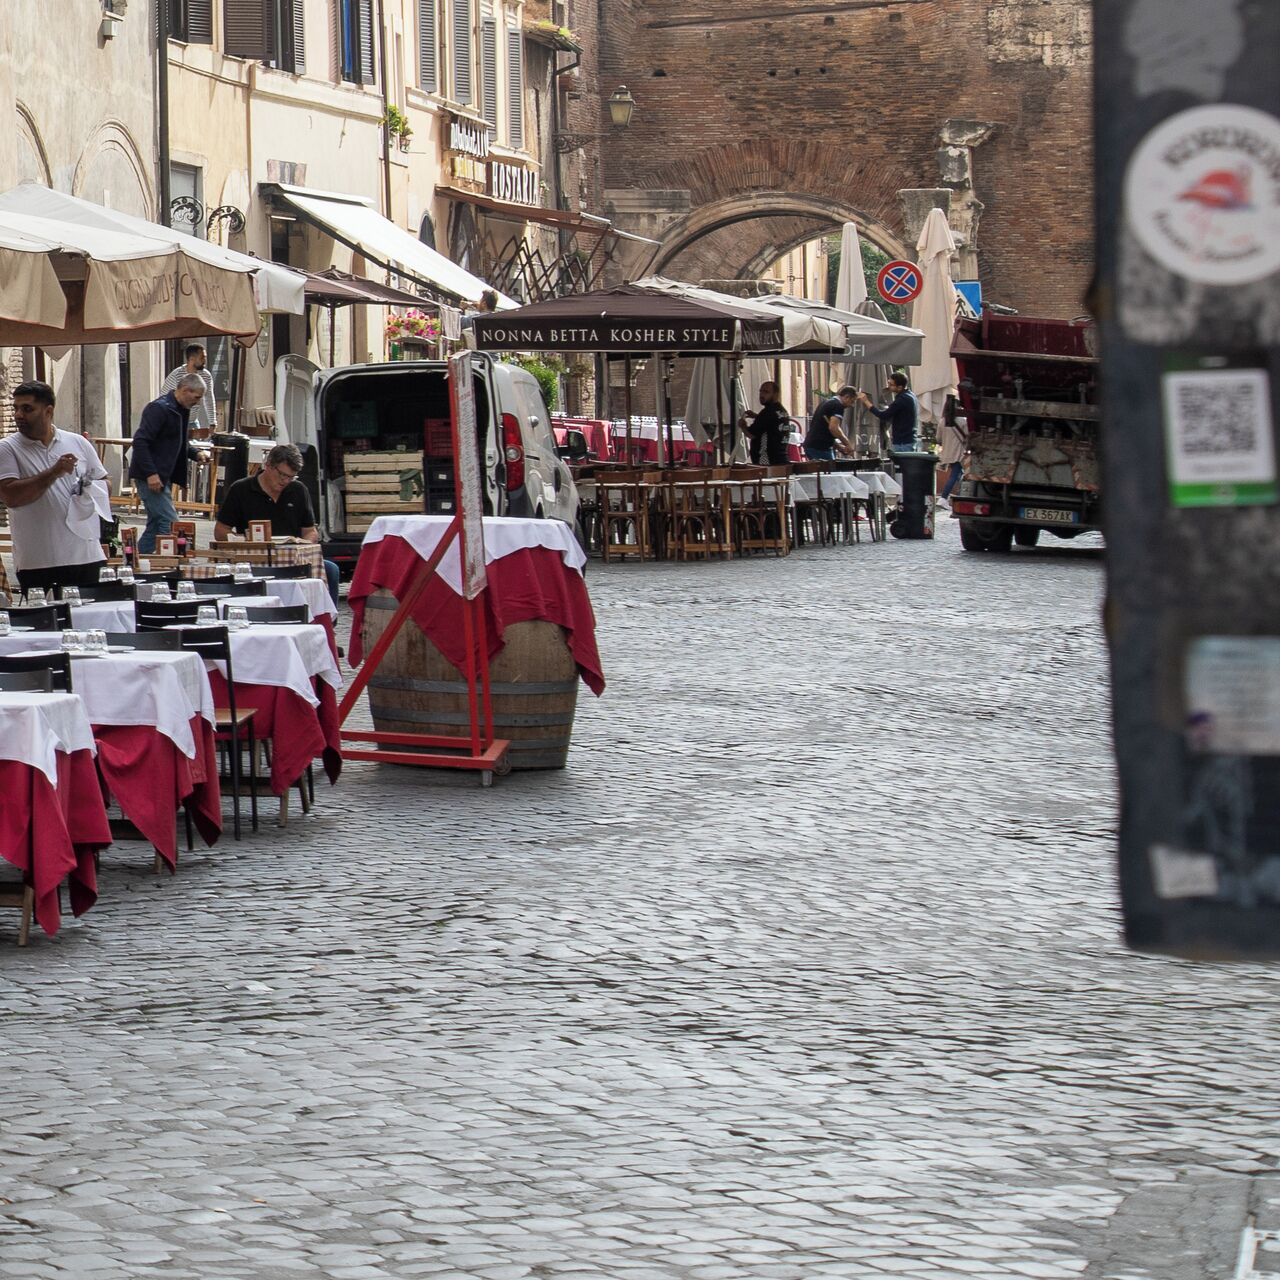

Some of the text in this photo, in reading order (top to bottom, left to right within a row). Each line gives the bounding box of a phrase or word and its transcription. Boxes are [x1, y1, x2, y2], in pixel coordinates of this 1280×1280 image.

[492, 161, 539, 206] HOSTARIA
[482, 328, 729, 342] NONNA BETTA KOSHER STYLE
[1026, 508, 1039, 519] EX
